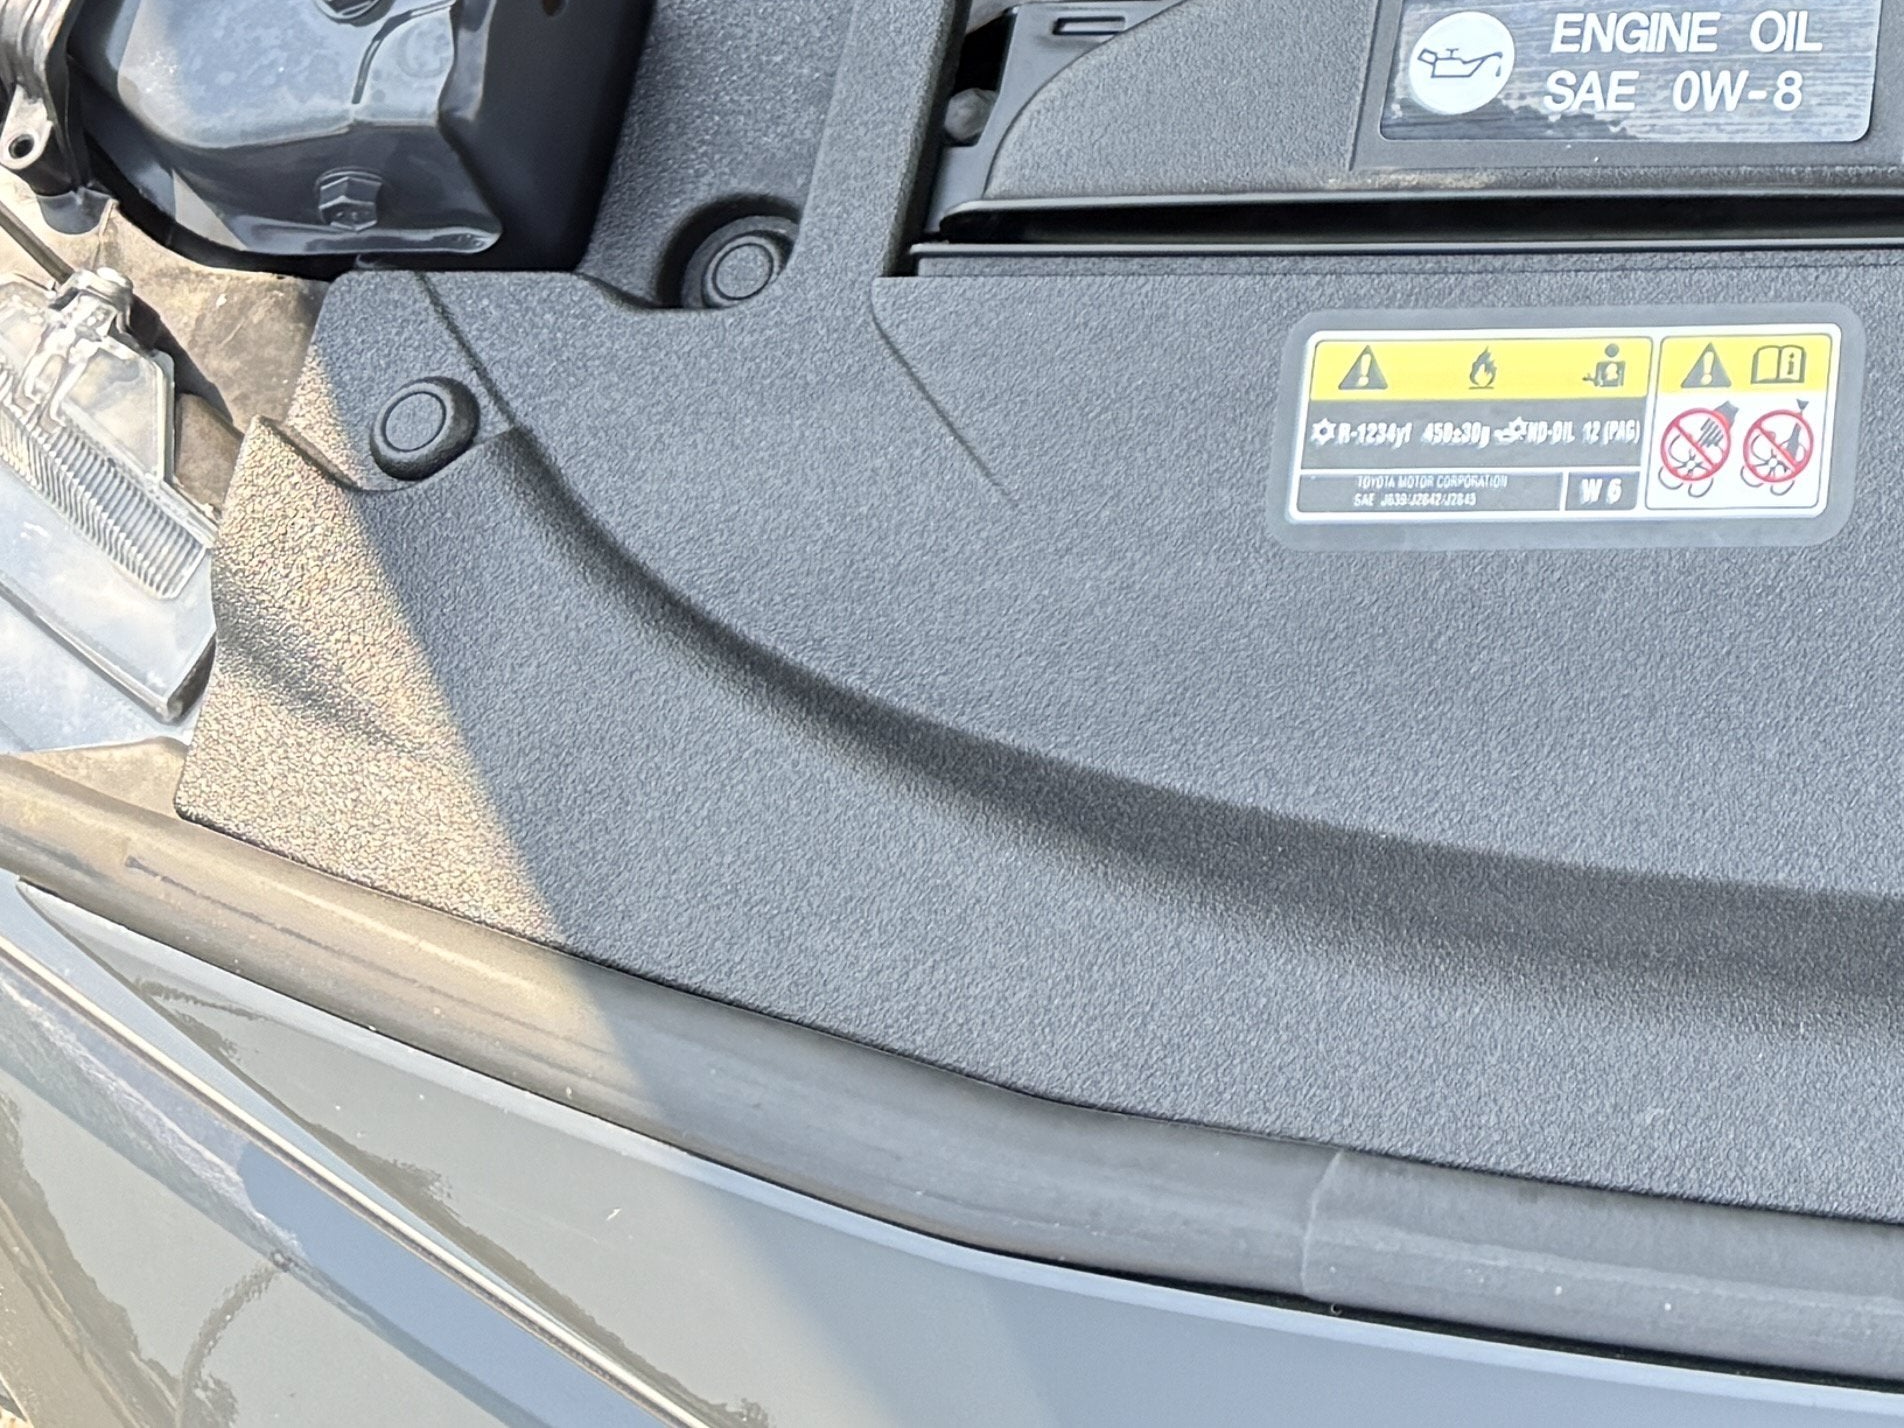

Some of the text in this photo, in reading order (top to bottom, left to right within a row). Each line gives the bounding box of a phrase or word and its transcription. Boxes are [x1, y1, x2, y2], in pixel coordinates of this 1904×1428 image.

[1550, 9, 1823, 54] ENGINE OIL
[1543, 69, 1803, 112] SAE 0W-8
[1527, 420, 1574, 443] ND-OIL
[1583, 421, 1601, 442] 12
[1604, 419, 1640, 444] (PAG)
[1357, 474, 1507, 489] TOYOTA MOTOR CORPORATION
[1580, 478, 1622, 505] W 6
